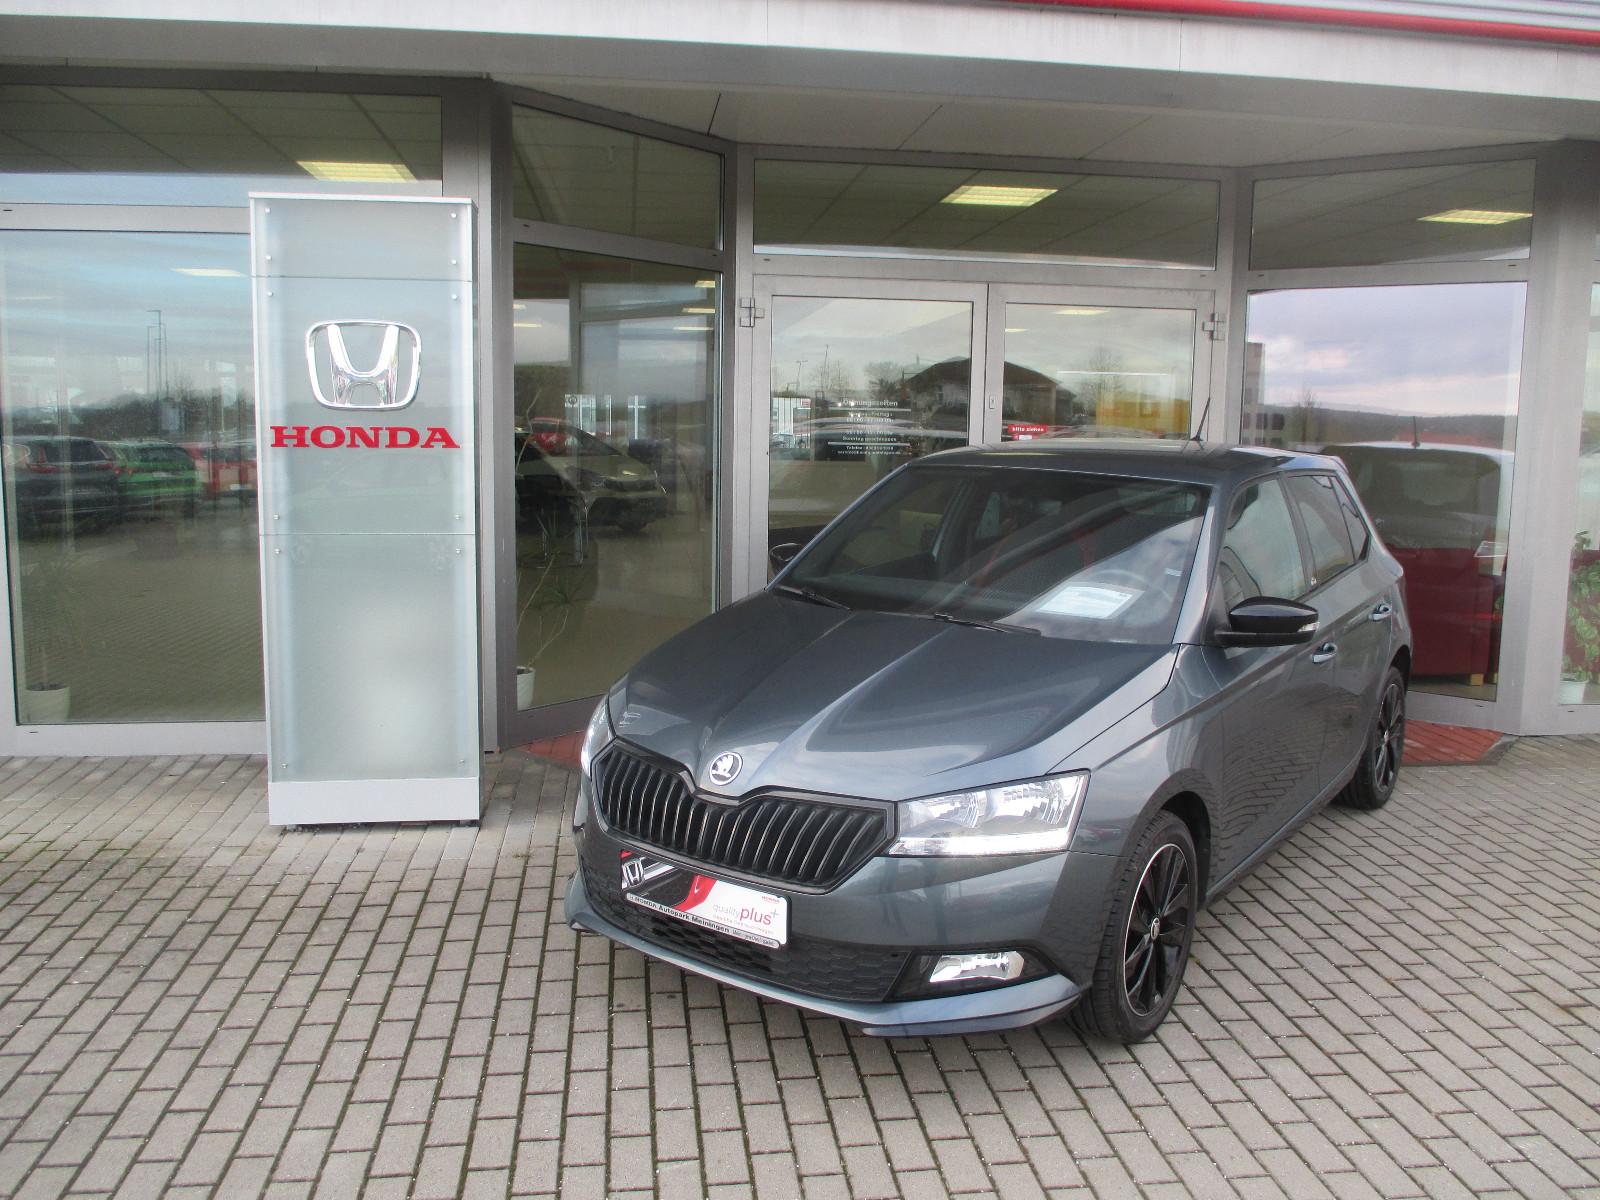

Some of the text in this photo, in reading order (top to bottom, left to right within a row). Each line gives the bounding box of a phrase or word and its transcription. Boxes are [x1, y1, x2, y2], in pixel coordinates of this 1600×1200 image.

[270, 425, 460, 448] HONDA
[659, 904, 690, 920] Autopark
[691, 915, 730, 933] Meiningen
